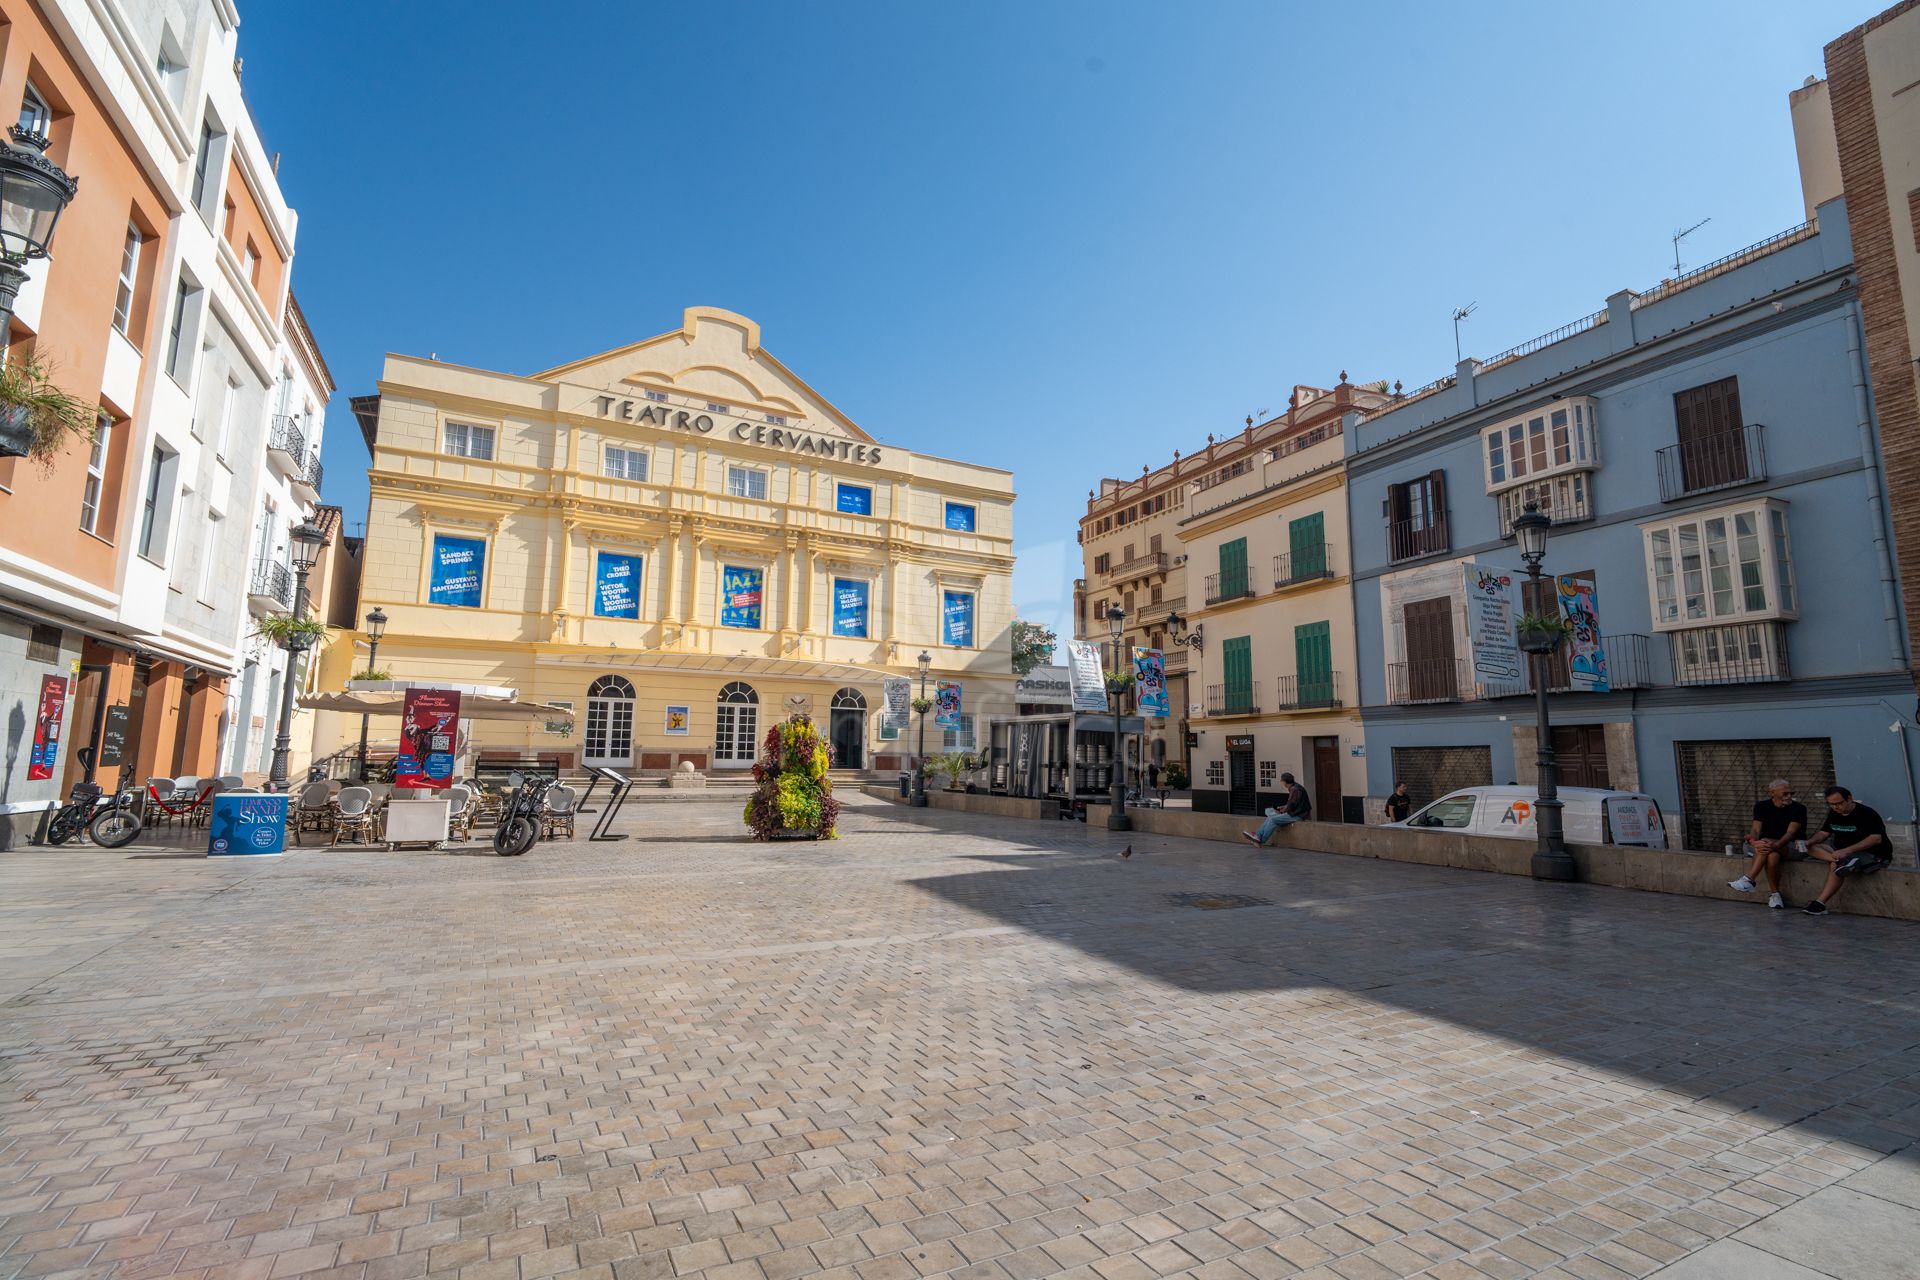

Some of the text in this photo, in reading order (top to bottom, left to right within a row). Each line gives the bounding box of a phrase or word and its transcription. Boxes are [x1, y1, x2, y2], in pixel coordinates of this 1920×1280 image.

[599, 395, 882, 464] TEATRO CERVANTES
[441, 551, 474, 560] KANDACE
[442, 557, 472, 565] SPRINGS
[445, 576, 477, 584] GUSTAVO
[724, 572, 763, 591] JAZZ
[432, 582, 479, 592] SANTAOLALLA
[601, 588, 629, 596] WOOTEN
[604, 599, 631, 607] WOOTEN
[605, 603, 636, 611] BROTHERS
[240, 798, 282, 807] FLAMENCO
[239, 811, 281, 824] Show
